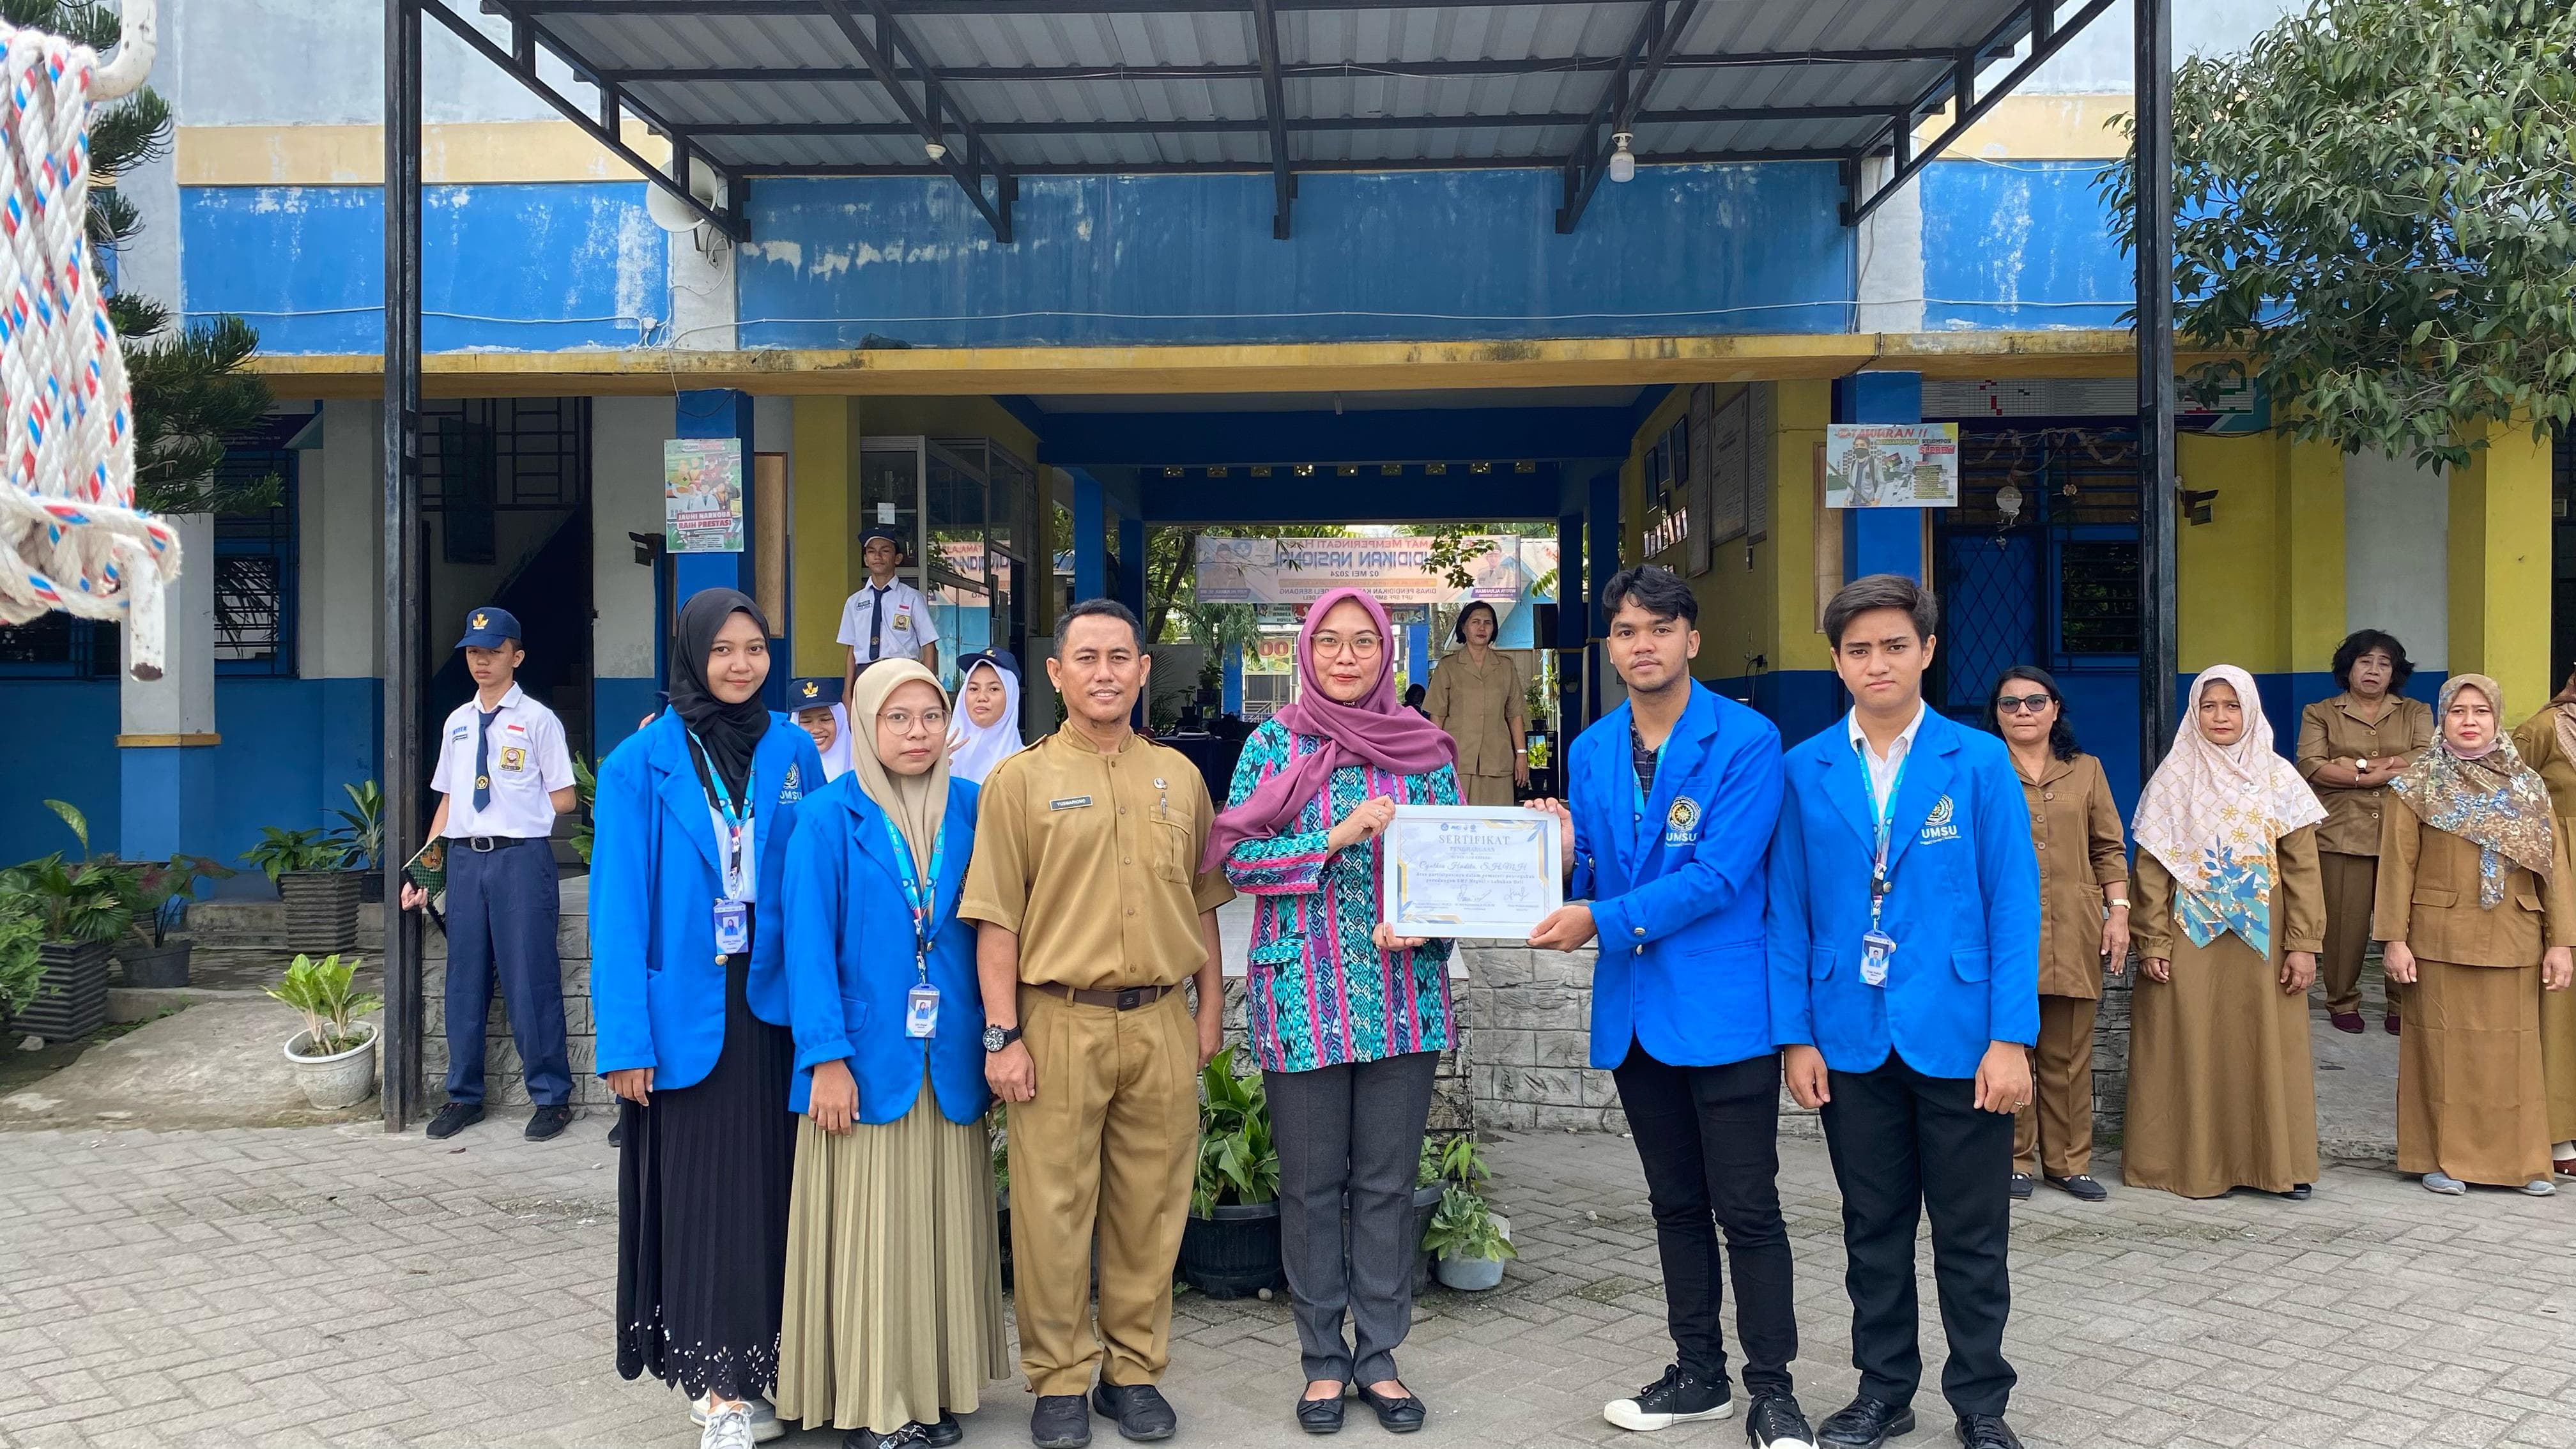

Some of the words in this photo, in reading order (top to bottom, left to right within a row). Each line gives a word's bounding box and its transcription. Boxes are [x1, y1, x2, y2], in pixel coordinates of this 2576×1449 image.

[698, 519, 732, 528] PRESTASI
[1666, 832, 1698, 841] UMSU
[1920, 824, 1958, 839] UMSU
[1439, 834, 1510, 845] SERTIFIKAT
